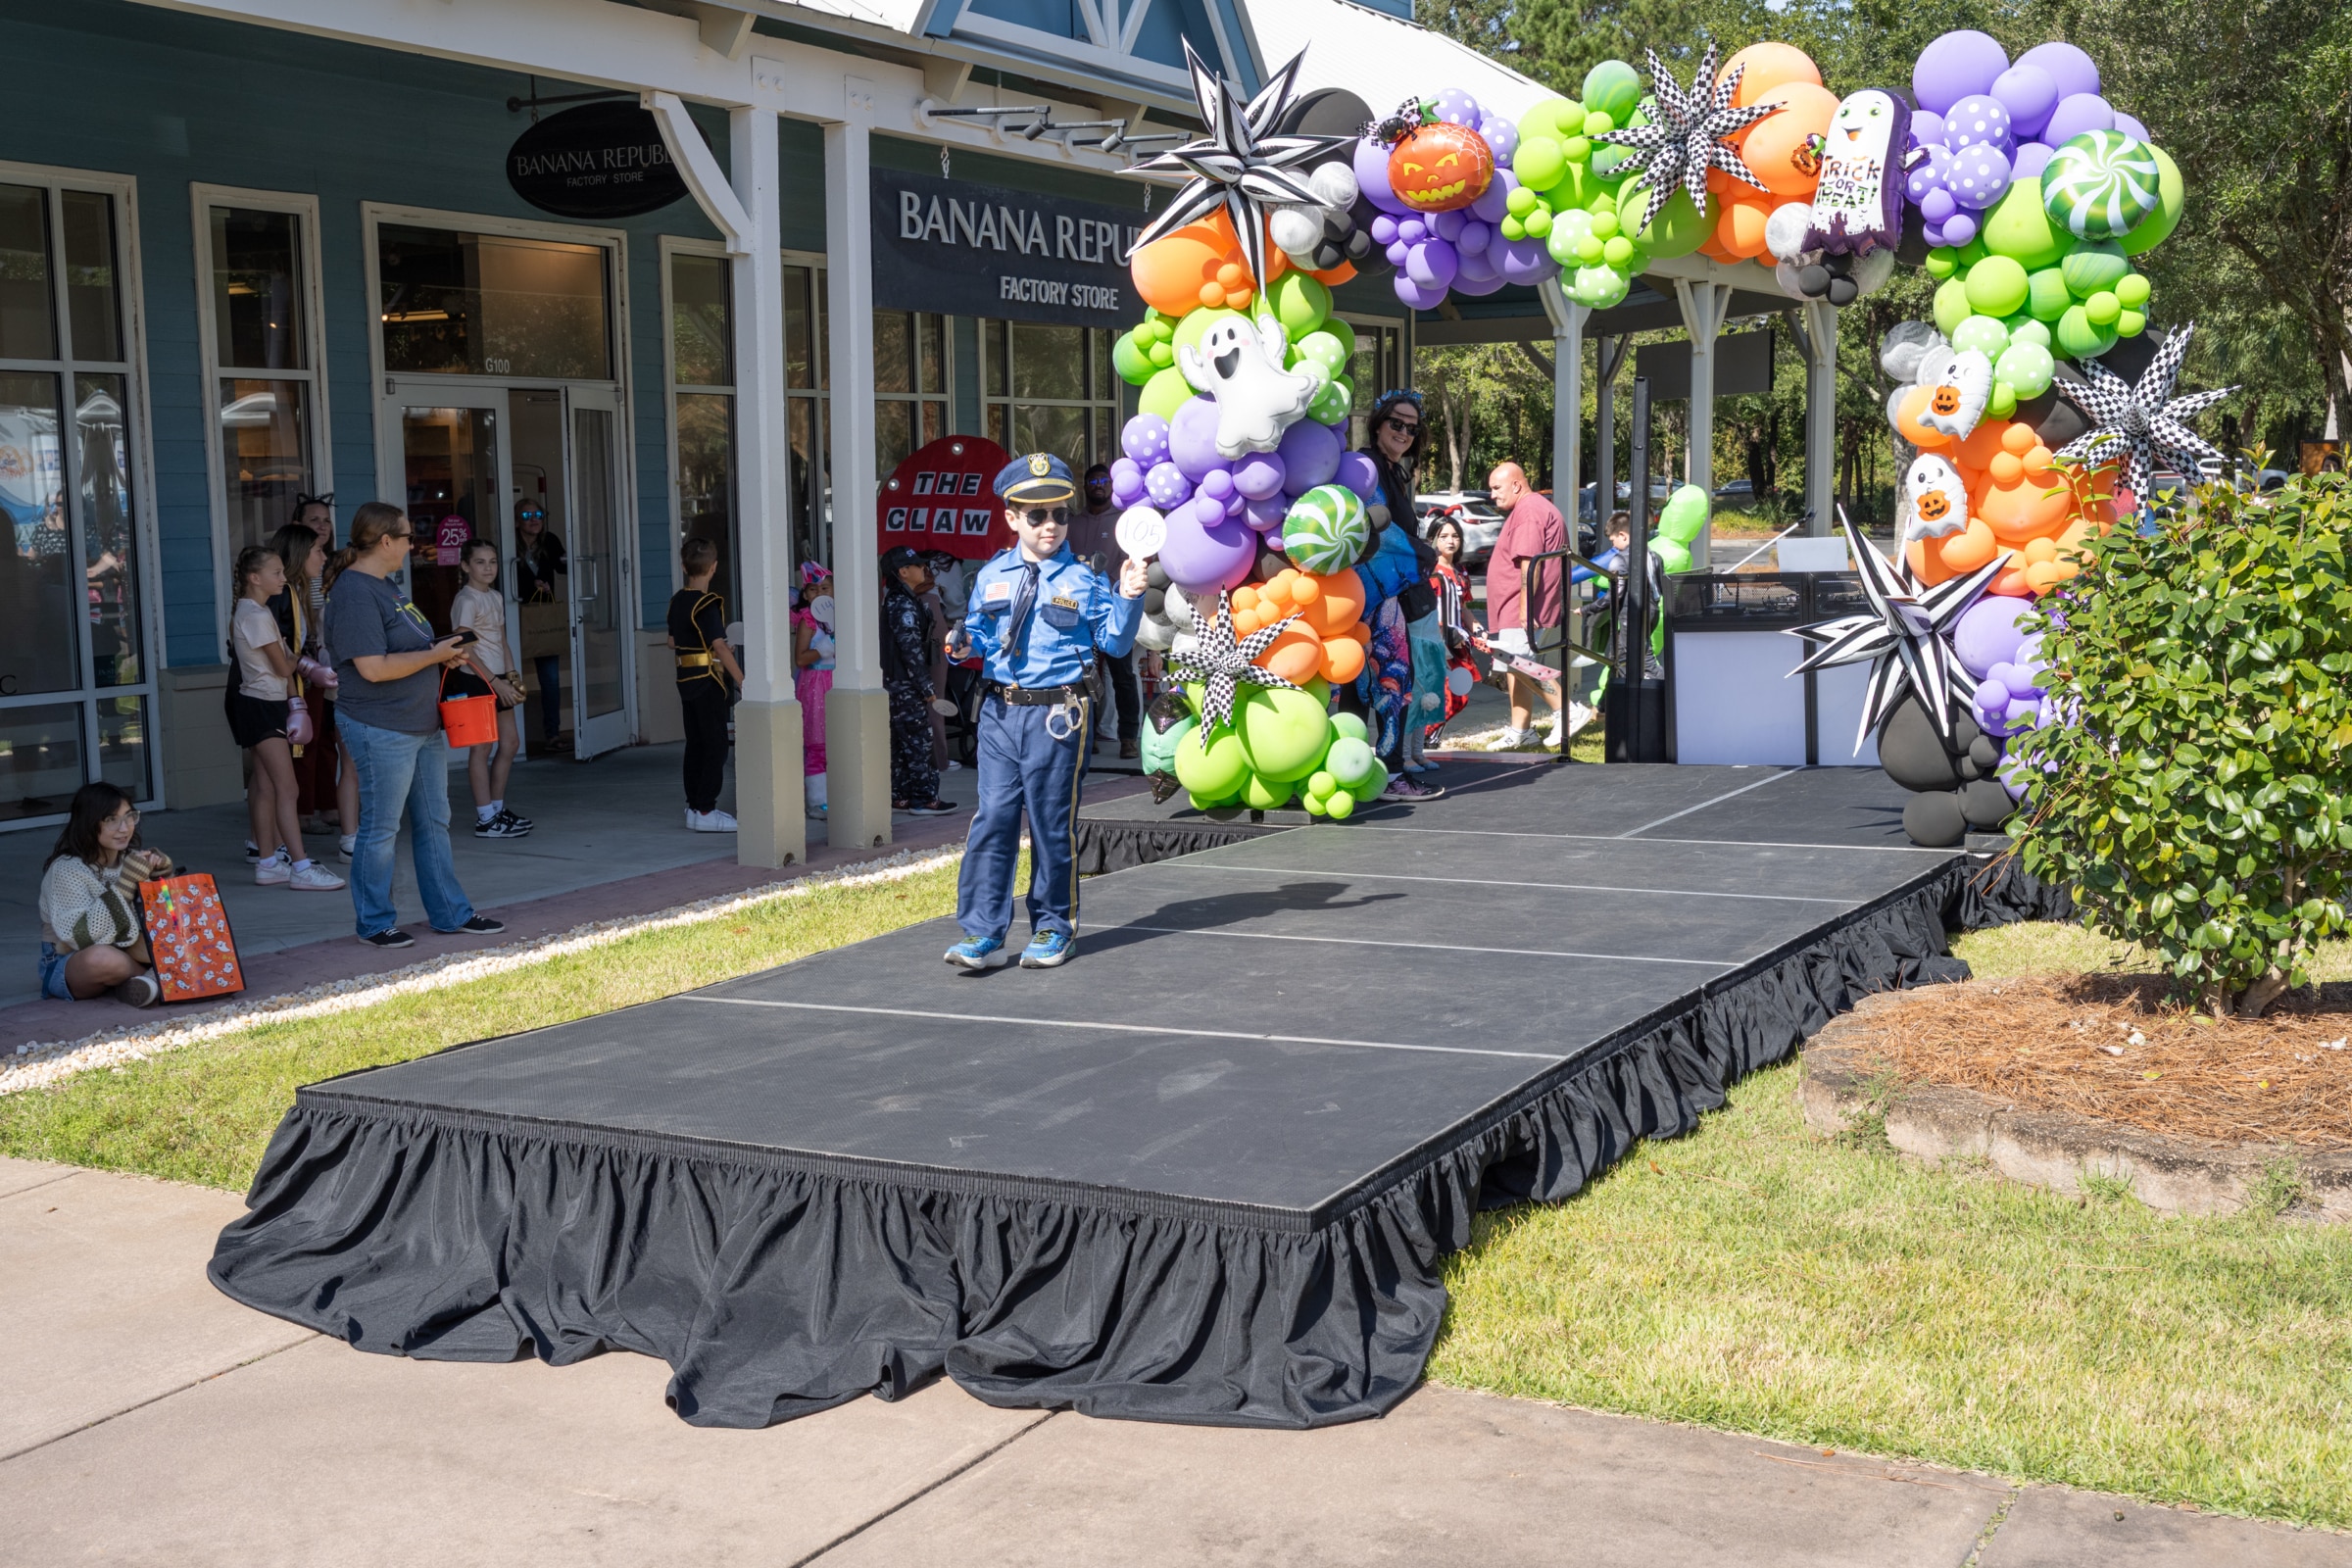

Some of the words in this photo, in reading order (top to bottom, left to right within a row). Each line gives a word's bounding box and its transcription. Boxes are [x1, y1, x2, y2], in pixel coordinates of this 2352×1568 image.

[516, 151, 596, 176] BANANA
[567, 174, 607, 187] FACTORY
[613, 172, 644, 184] STORE
[900, 191, 1050, 258] BANANA
[1055, 215, 1144, 268] REPU
[1000, 275, 1068, 305] FACTORY
[1071, 283, 1119, 311] STORE
[485, 358, 510, 373] G100
[917, 473, 982, 495] THE
[887, 508, 990, 532] CLAW
[1124, 517, 1162, 547] 105
[1054, 598, 1075, 607] POLICE
